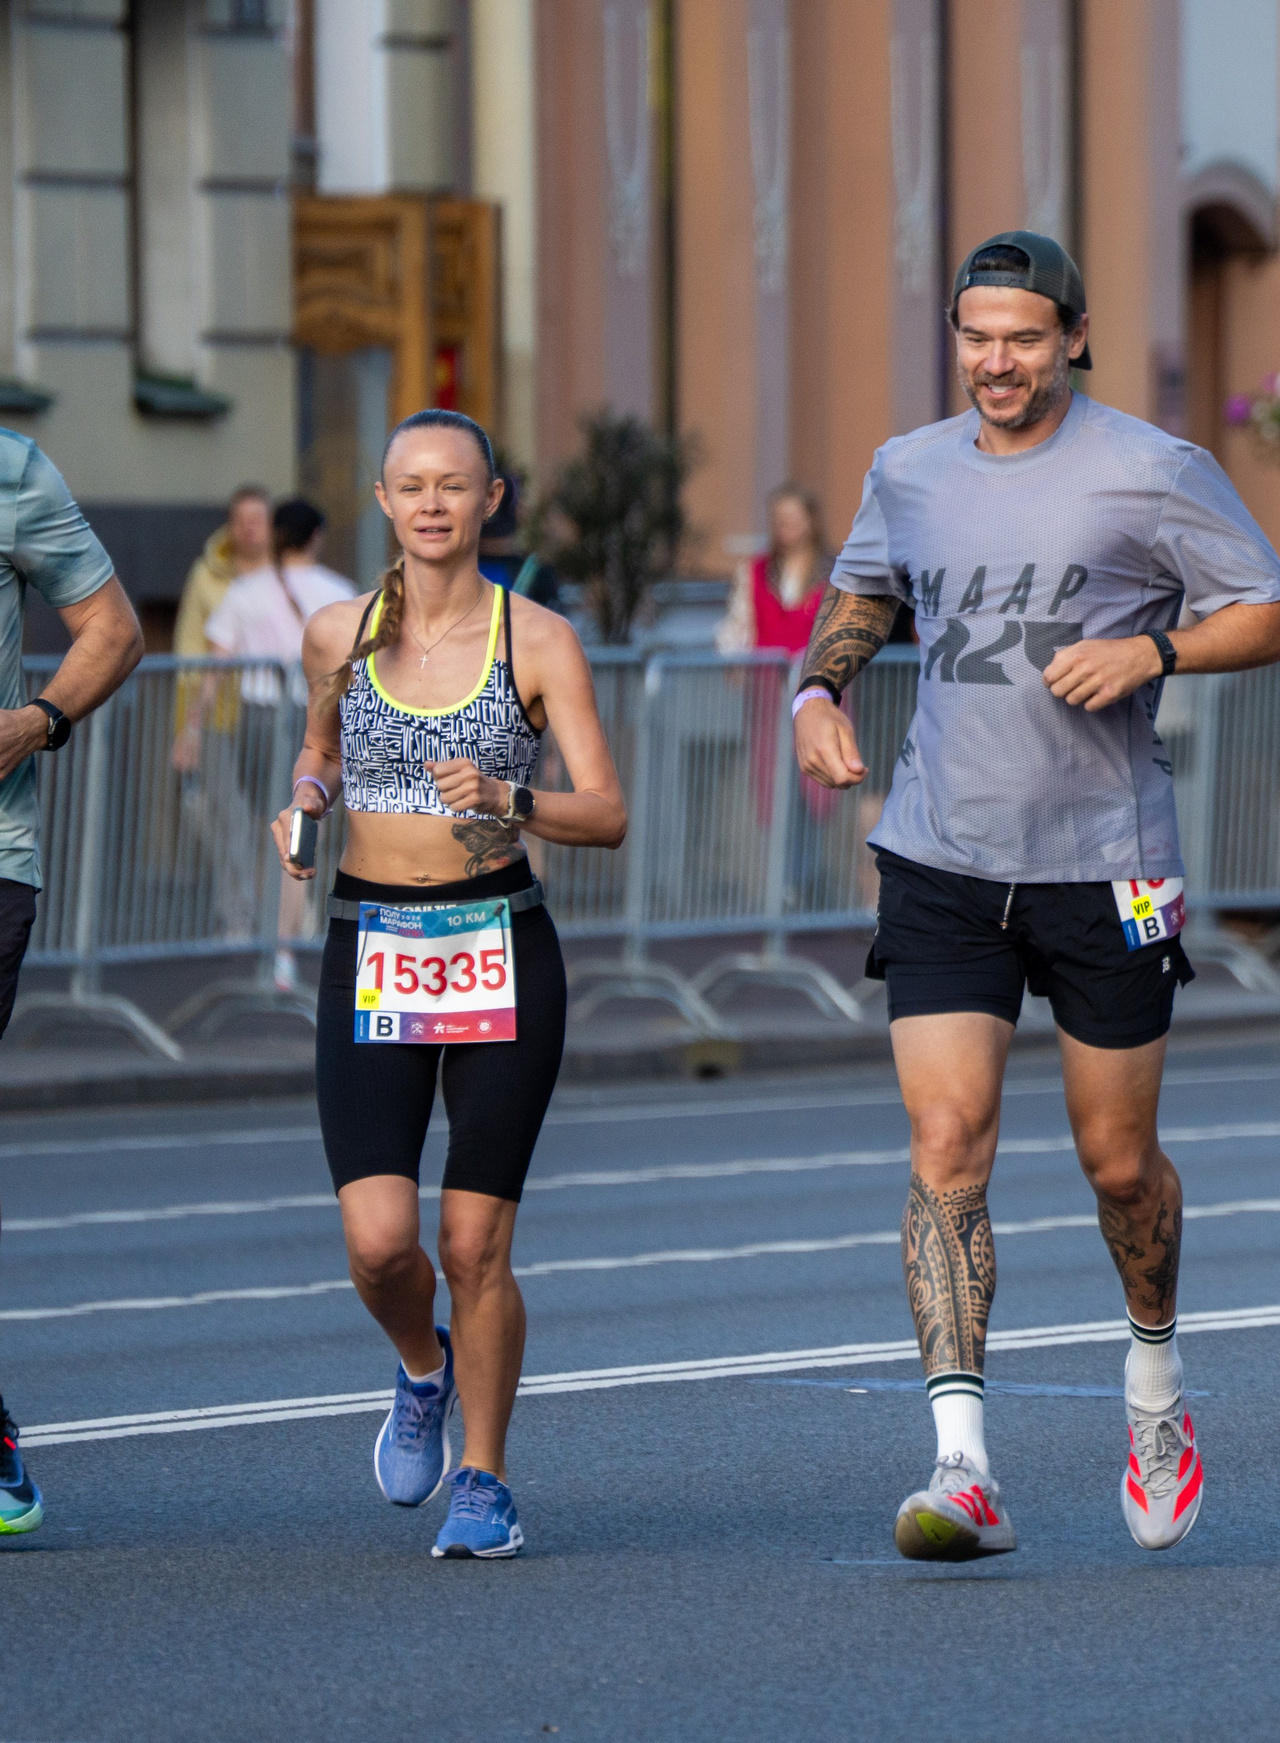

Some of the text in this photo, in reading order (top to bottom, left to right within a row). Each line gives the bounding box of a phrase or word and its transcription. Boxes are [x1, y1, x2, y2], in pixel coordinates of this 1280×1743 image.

[921, 563, 1088, 616] MAAP
[1133, 900, 1150, 916] VIP
[379, 916, 422, 930] МАРАФОН
[447, 915, 462, 927] 10
[1143, 916, 1160, 940] B
[366, 948, 507, 997] 15335
[362, 994, 377, 1004] VIP
[375, 1015, 393, 1038] B
